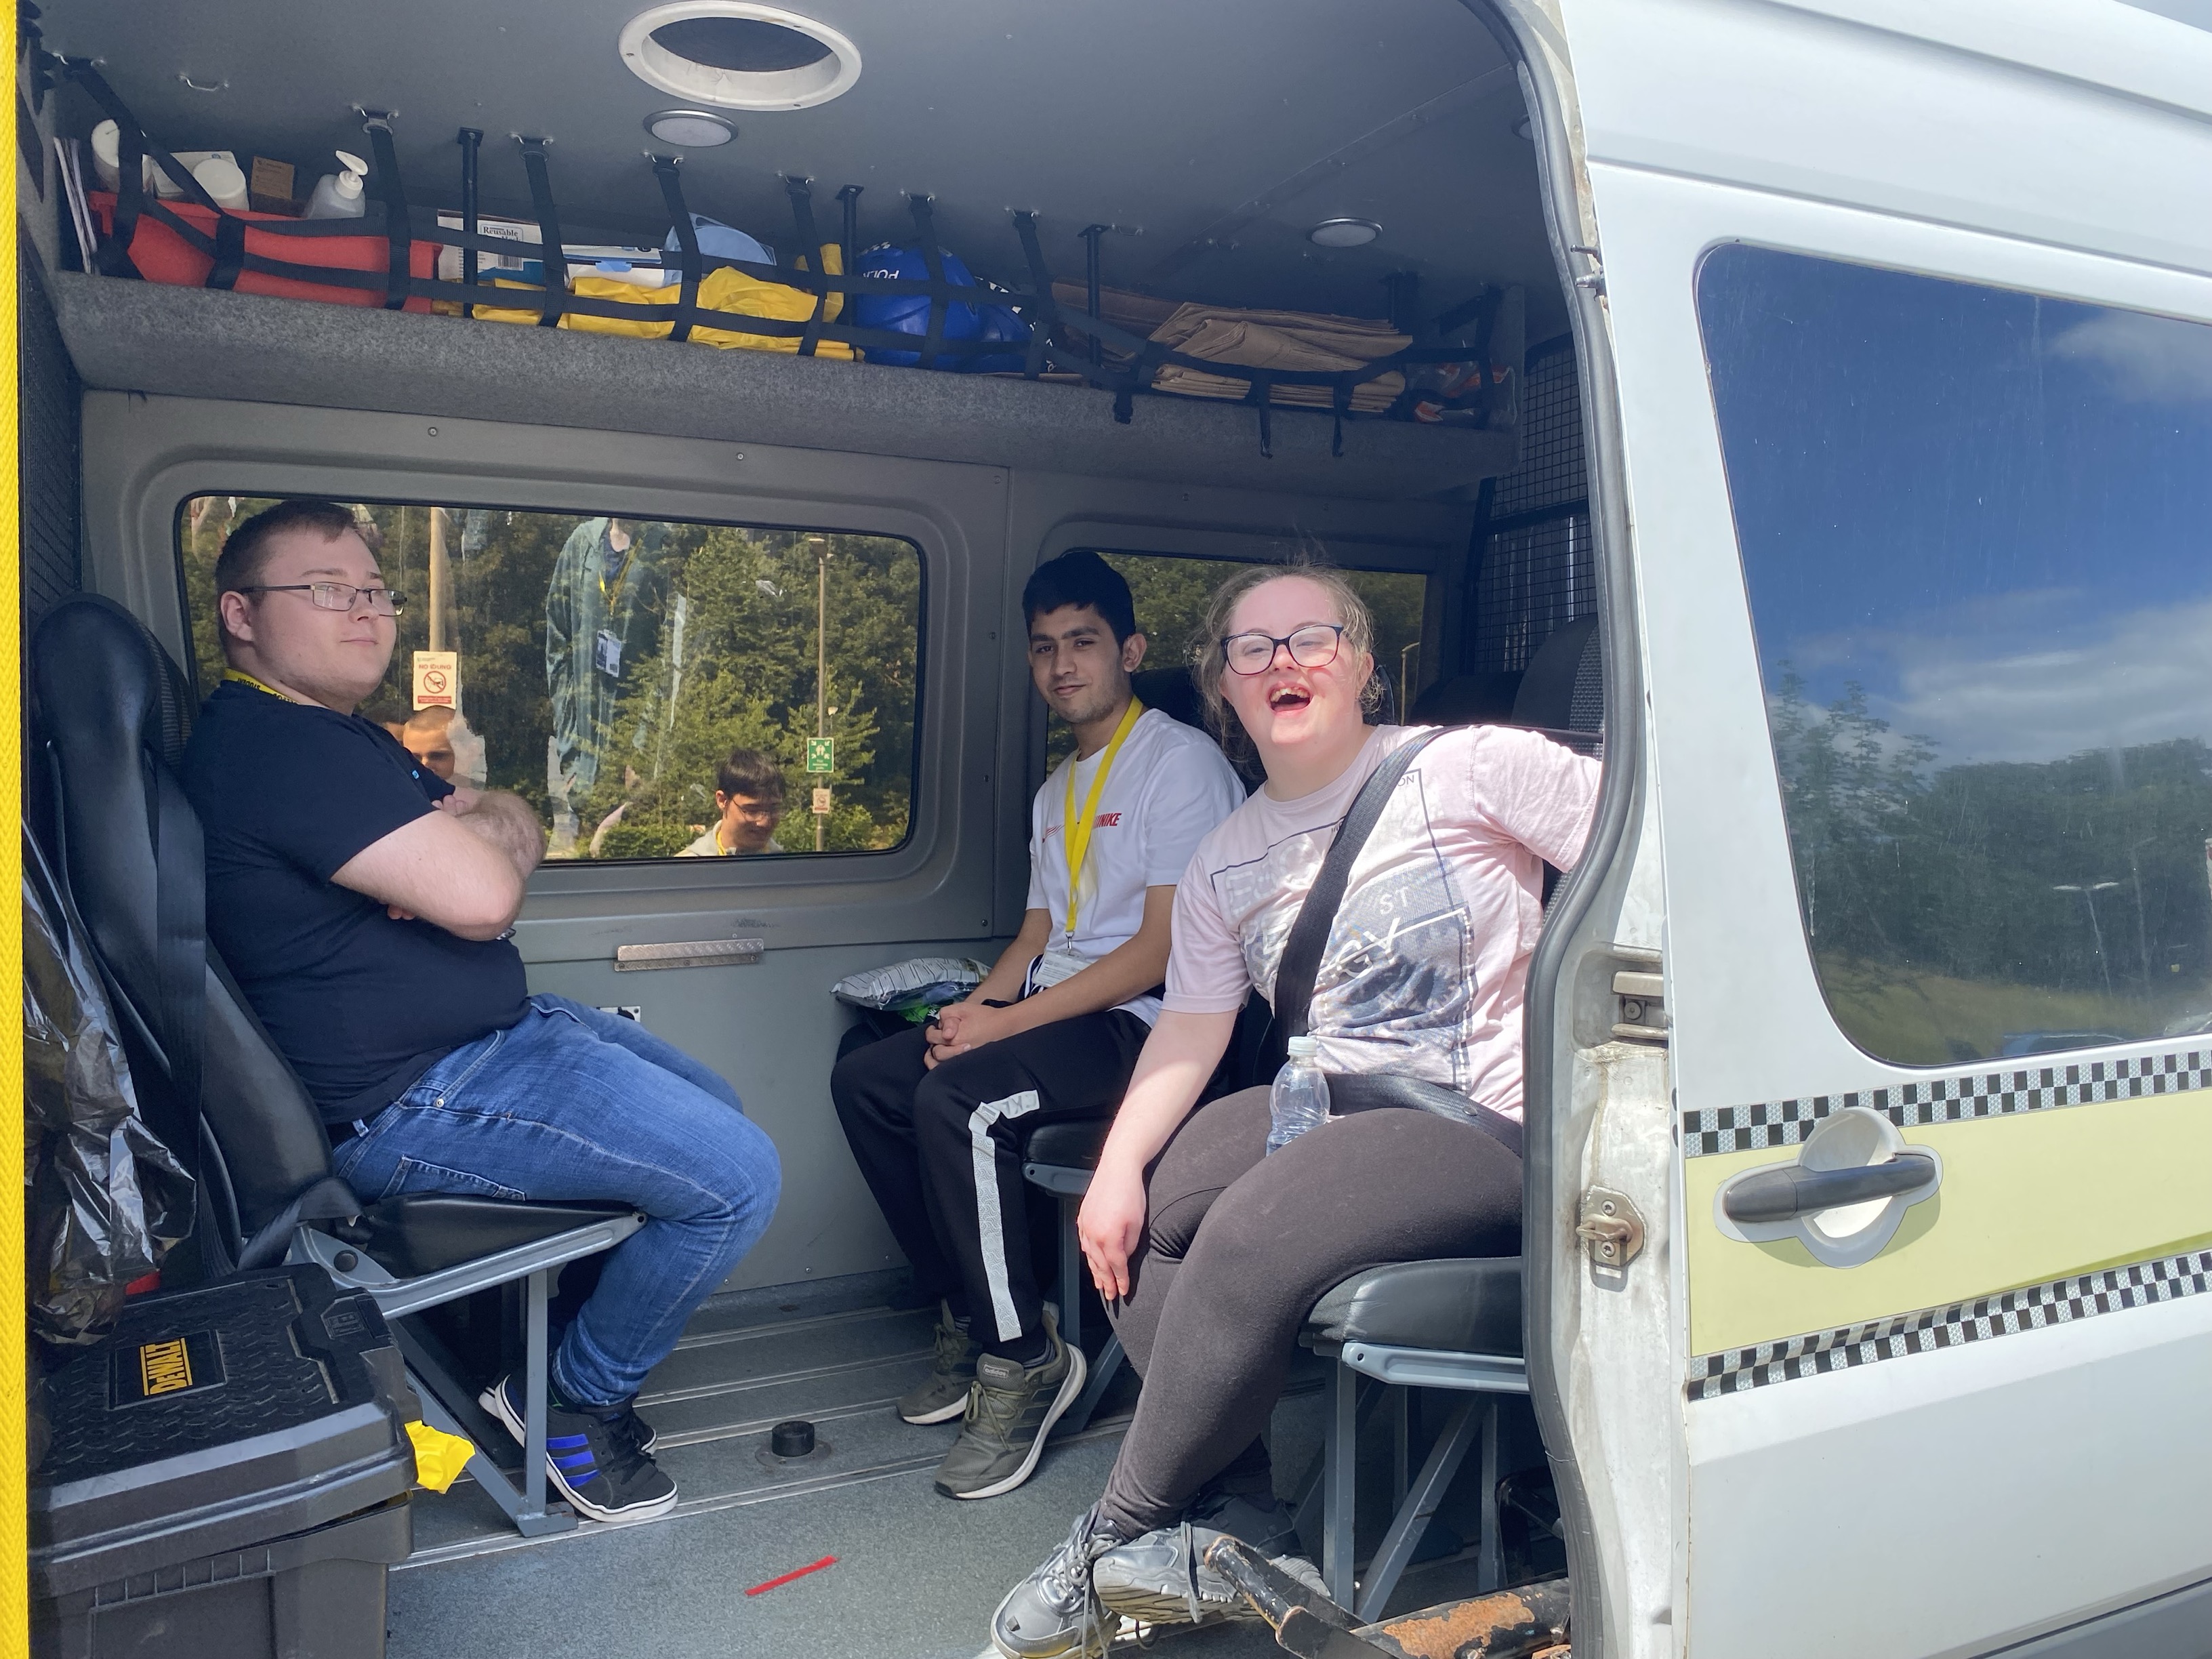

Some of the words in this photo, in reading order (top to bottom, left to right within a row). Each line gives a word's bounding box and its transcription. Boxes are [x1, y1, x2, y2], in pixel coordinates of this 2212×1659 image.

[483, 226, 518, 237] Reusable
[1097, 813, 1122, 827] NIKE
[145, 1340, 188, 1395] DEWALT
[985, 1367, 1007, 1376] adidas
